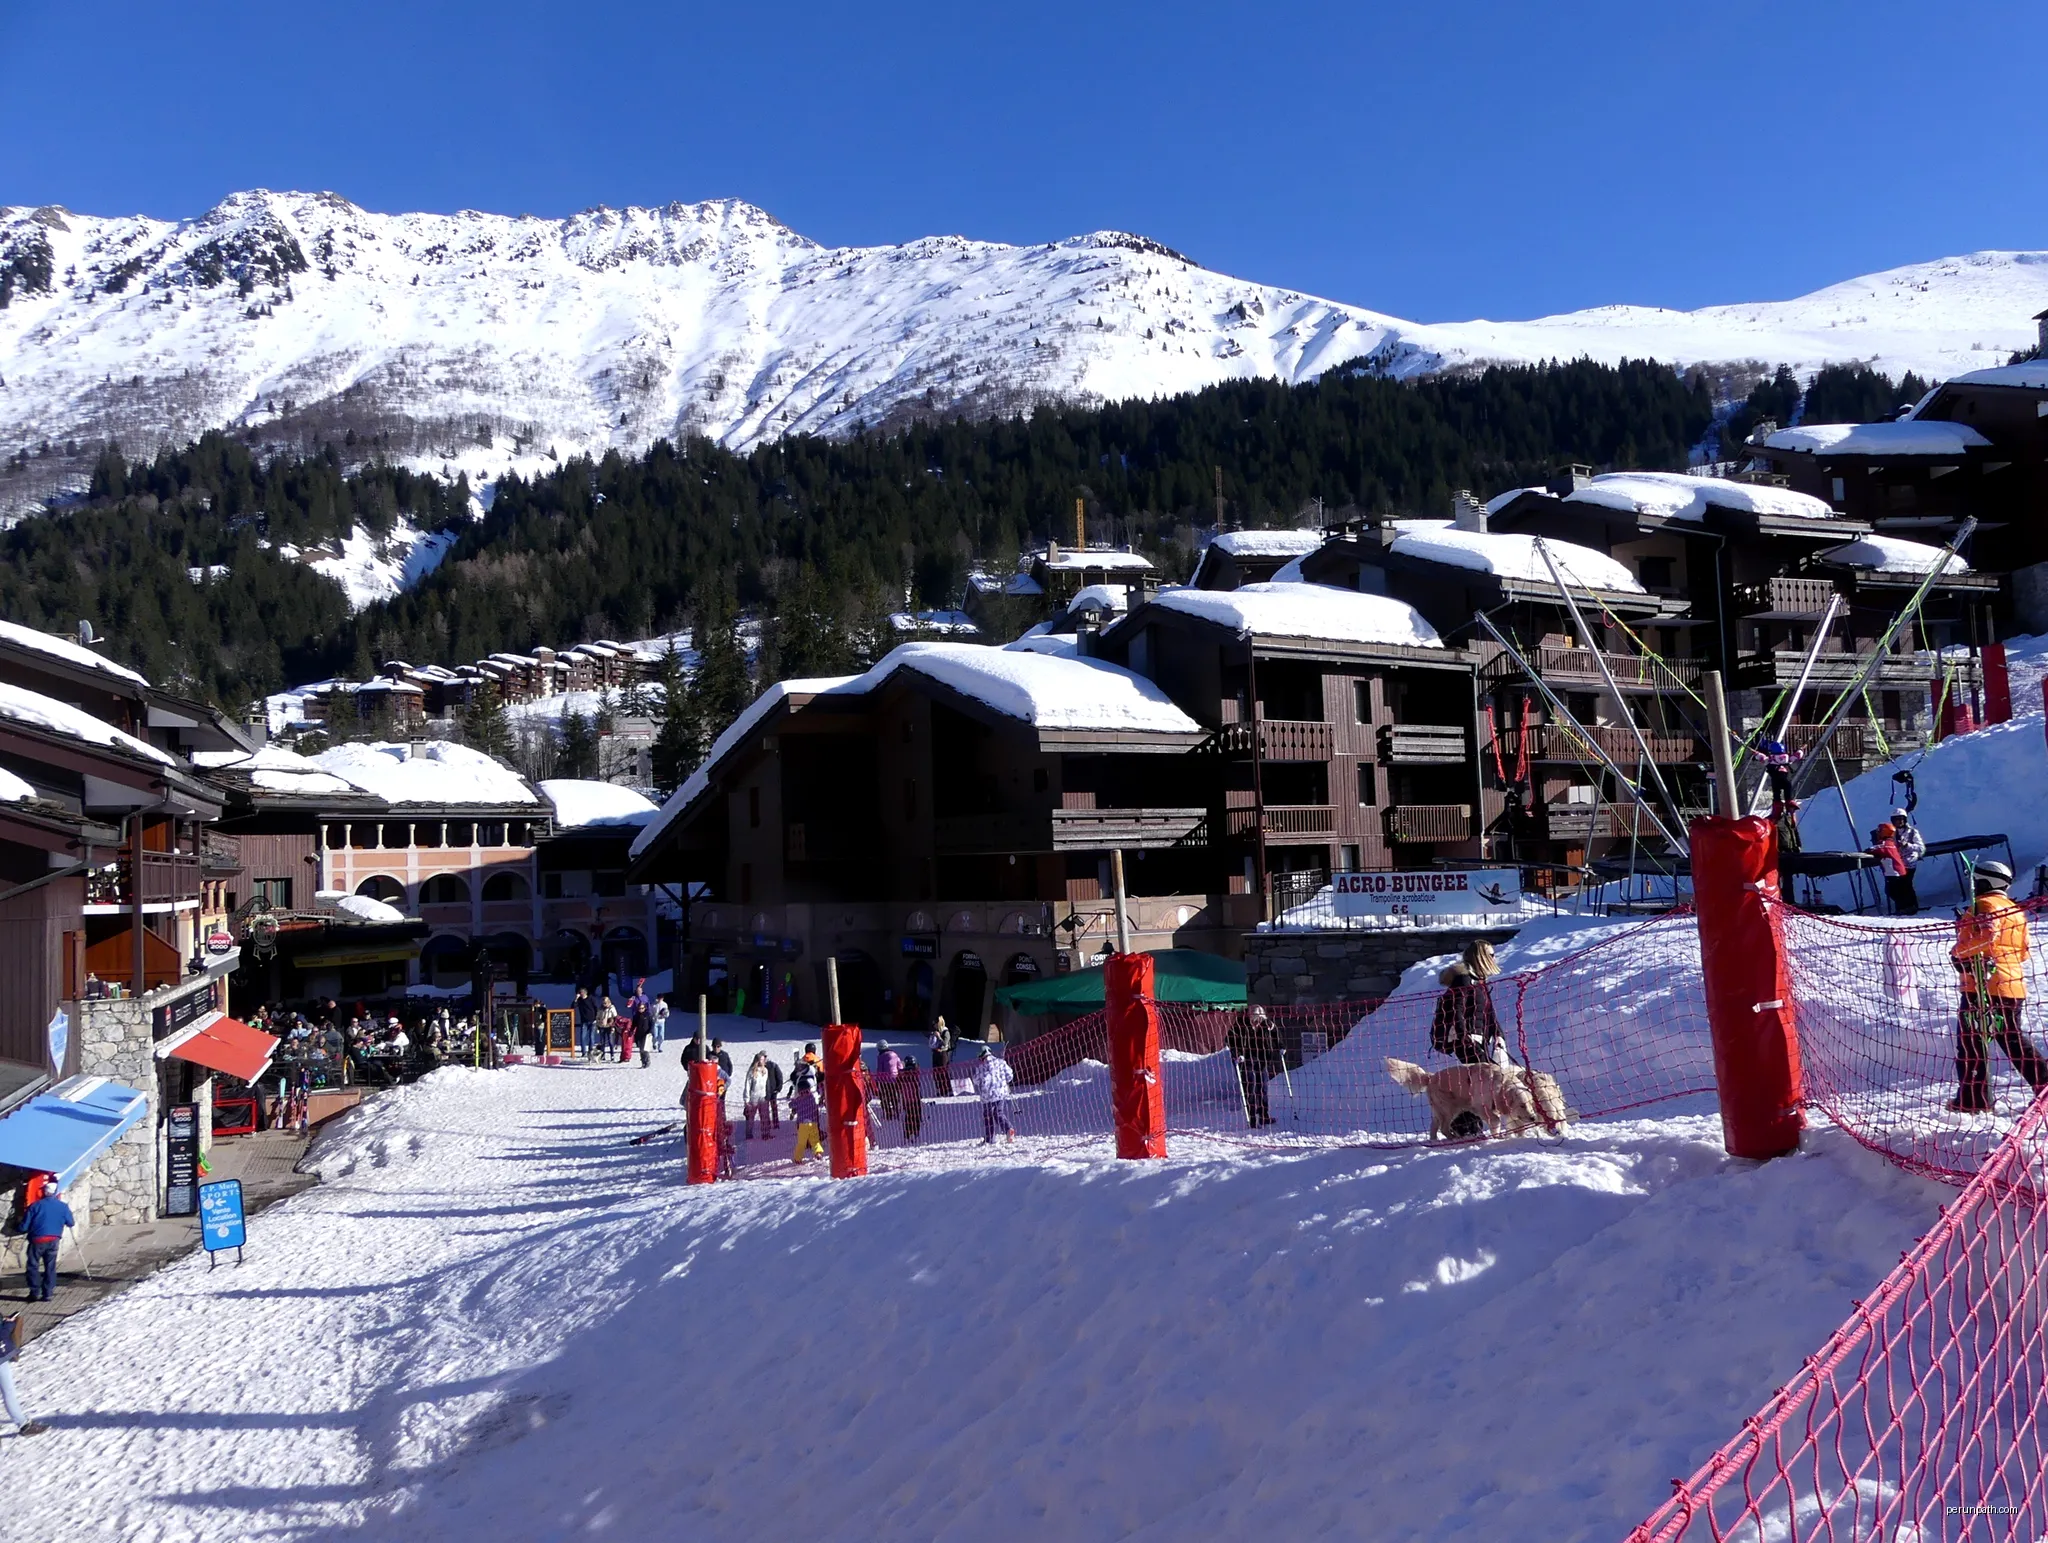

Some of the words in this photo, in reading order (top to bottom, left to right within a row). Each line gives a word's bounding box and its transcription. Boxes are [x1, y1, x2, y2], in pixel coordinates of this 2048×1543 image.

[1337, 874, 1468, 893] ACRO-BUNGEE
[1370, 894, 1400, 904] Trampoline
[1402, 893, 1436, 903] acrobatique
[1392, 905, 1398, 914] 6
[1402, 905, 1408, 914] €
[1015, 963, 1037, 971] CONSEIL
[200, 1188, 240, 1200] SPORTS
[208, 1213, 237, 1222] Location
